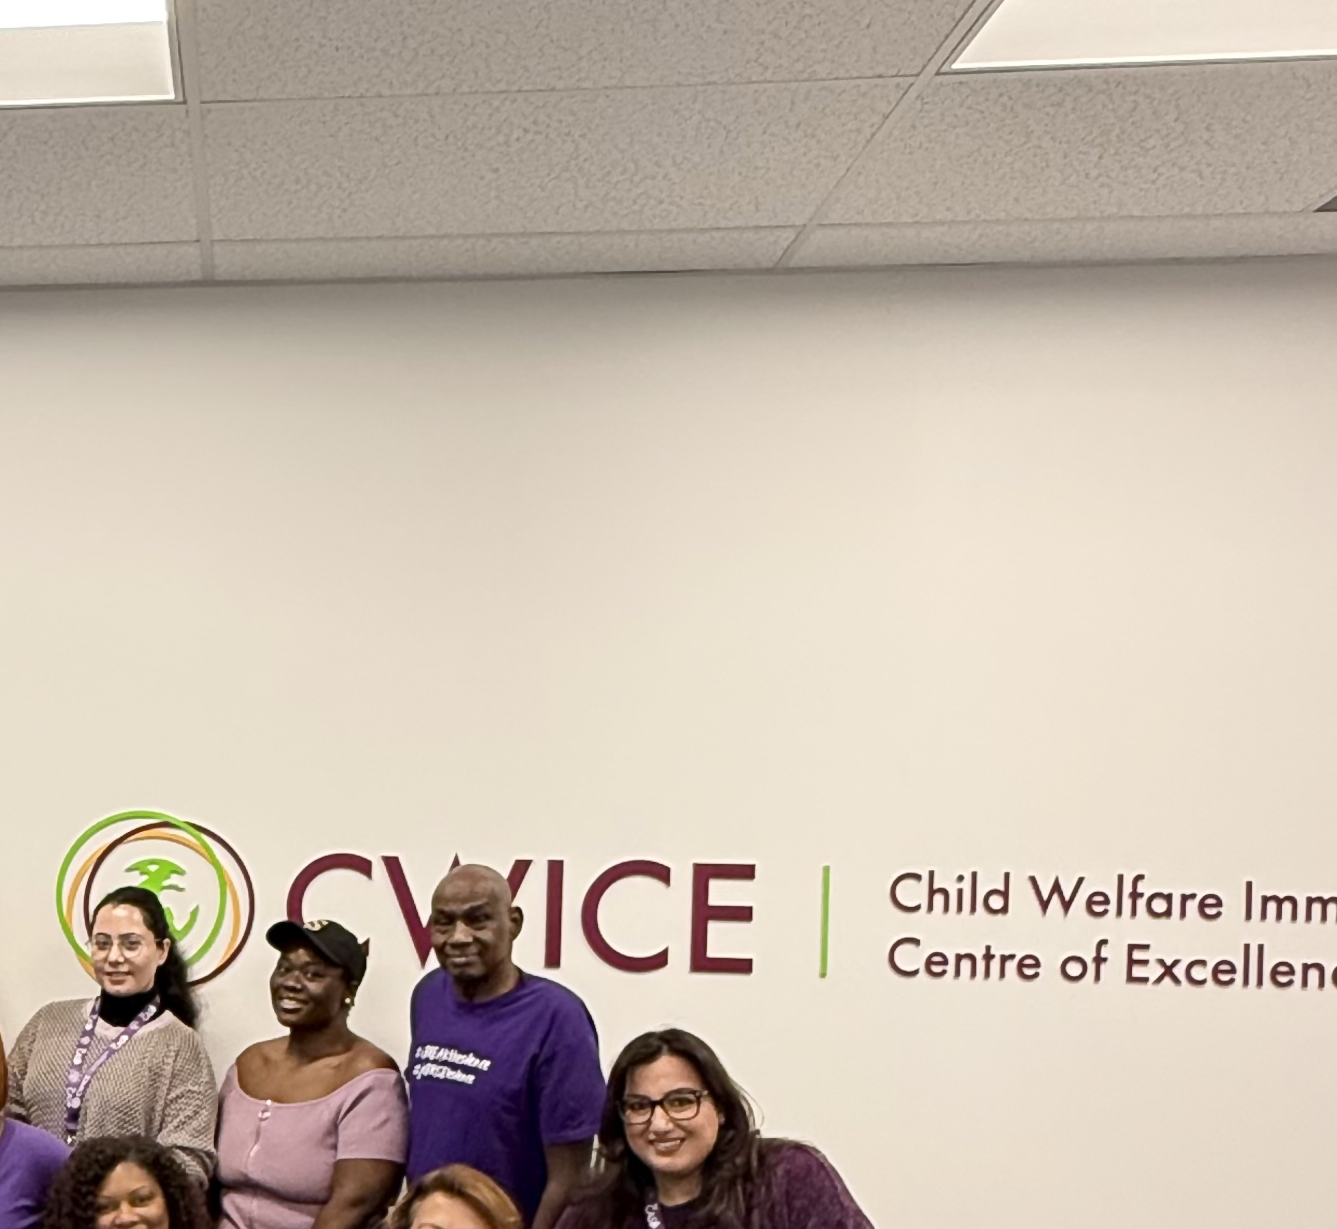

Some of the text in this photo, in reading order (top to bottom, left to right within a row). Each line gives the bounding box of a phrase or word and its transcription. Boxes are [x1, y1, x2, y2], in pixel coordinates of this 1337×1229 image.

[890, 870, 1337, 923] Child Welfare Imm
[889, 937, 1337, 989] Centre of Excellen
